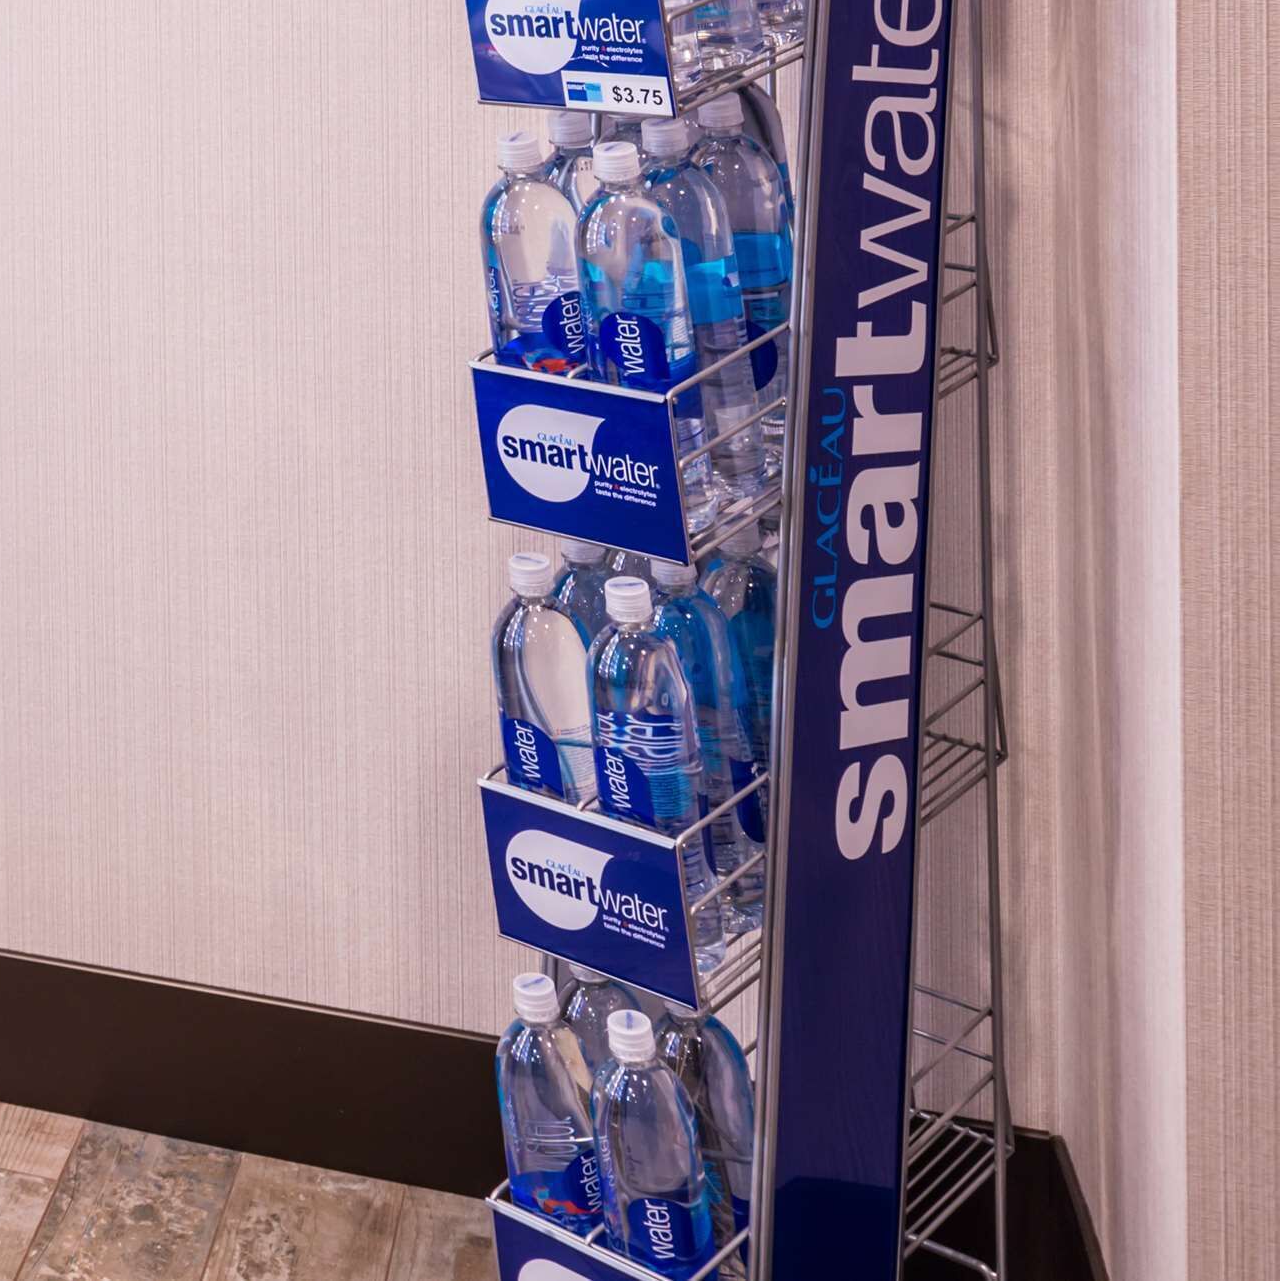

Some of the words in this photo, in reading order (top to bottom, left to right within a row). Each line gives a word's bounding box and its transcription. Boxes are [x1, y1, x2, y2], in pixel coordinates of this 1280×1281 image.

[491, 10, 645, 45] smartwater
[606, 46, 644, 56] electrolytes
[610, 55, 643, 64] difference
[612, 85, 663, 106] $3.75
[559, 296, 586, 355] water
[615, 314, 646, 377] water
[502, 435, 659, 489] smartwater
[619, 485, 657, 499] electrolytes
[624, 494, 657, 507] difference
[514, 720, 541, 780] water
[604, 748, 632, 809] water
[511, 856, 668, 931] smartwater
[644, 1199, 675, 1260] water
